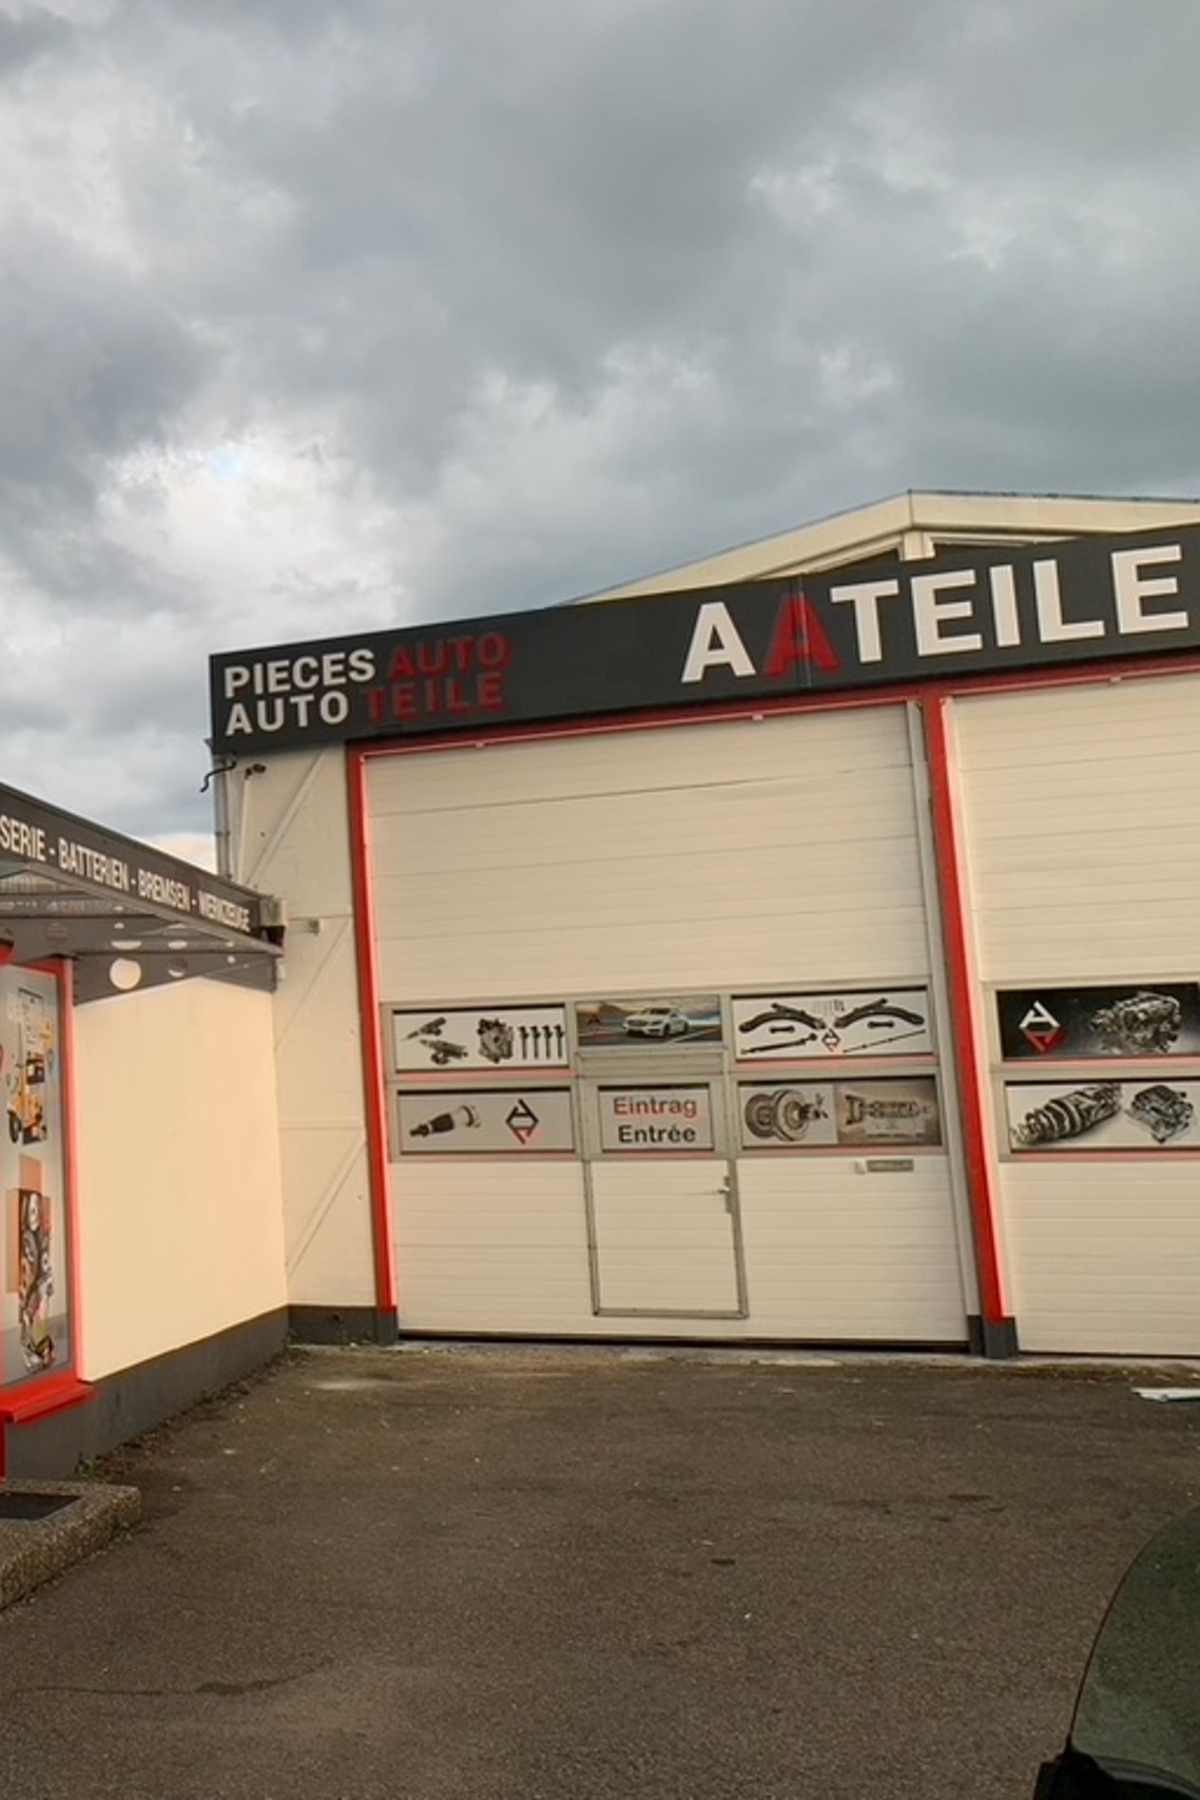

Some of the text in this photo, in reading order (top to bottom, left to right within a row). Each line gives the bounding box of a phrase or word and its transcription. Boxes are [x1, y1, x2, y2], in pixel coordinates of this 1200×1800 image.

[681, 544, 1189, 682] AATEILE
[224, 633, 512, 698] PIECES AUTO
[225, 672, 508, 736] AUTO TEILE
[58, 837, 129, 892] BATTERIEN
[613, 1096, 697, 1119] Eintrag
[617, 1124, 697, 1143] Entrée
